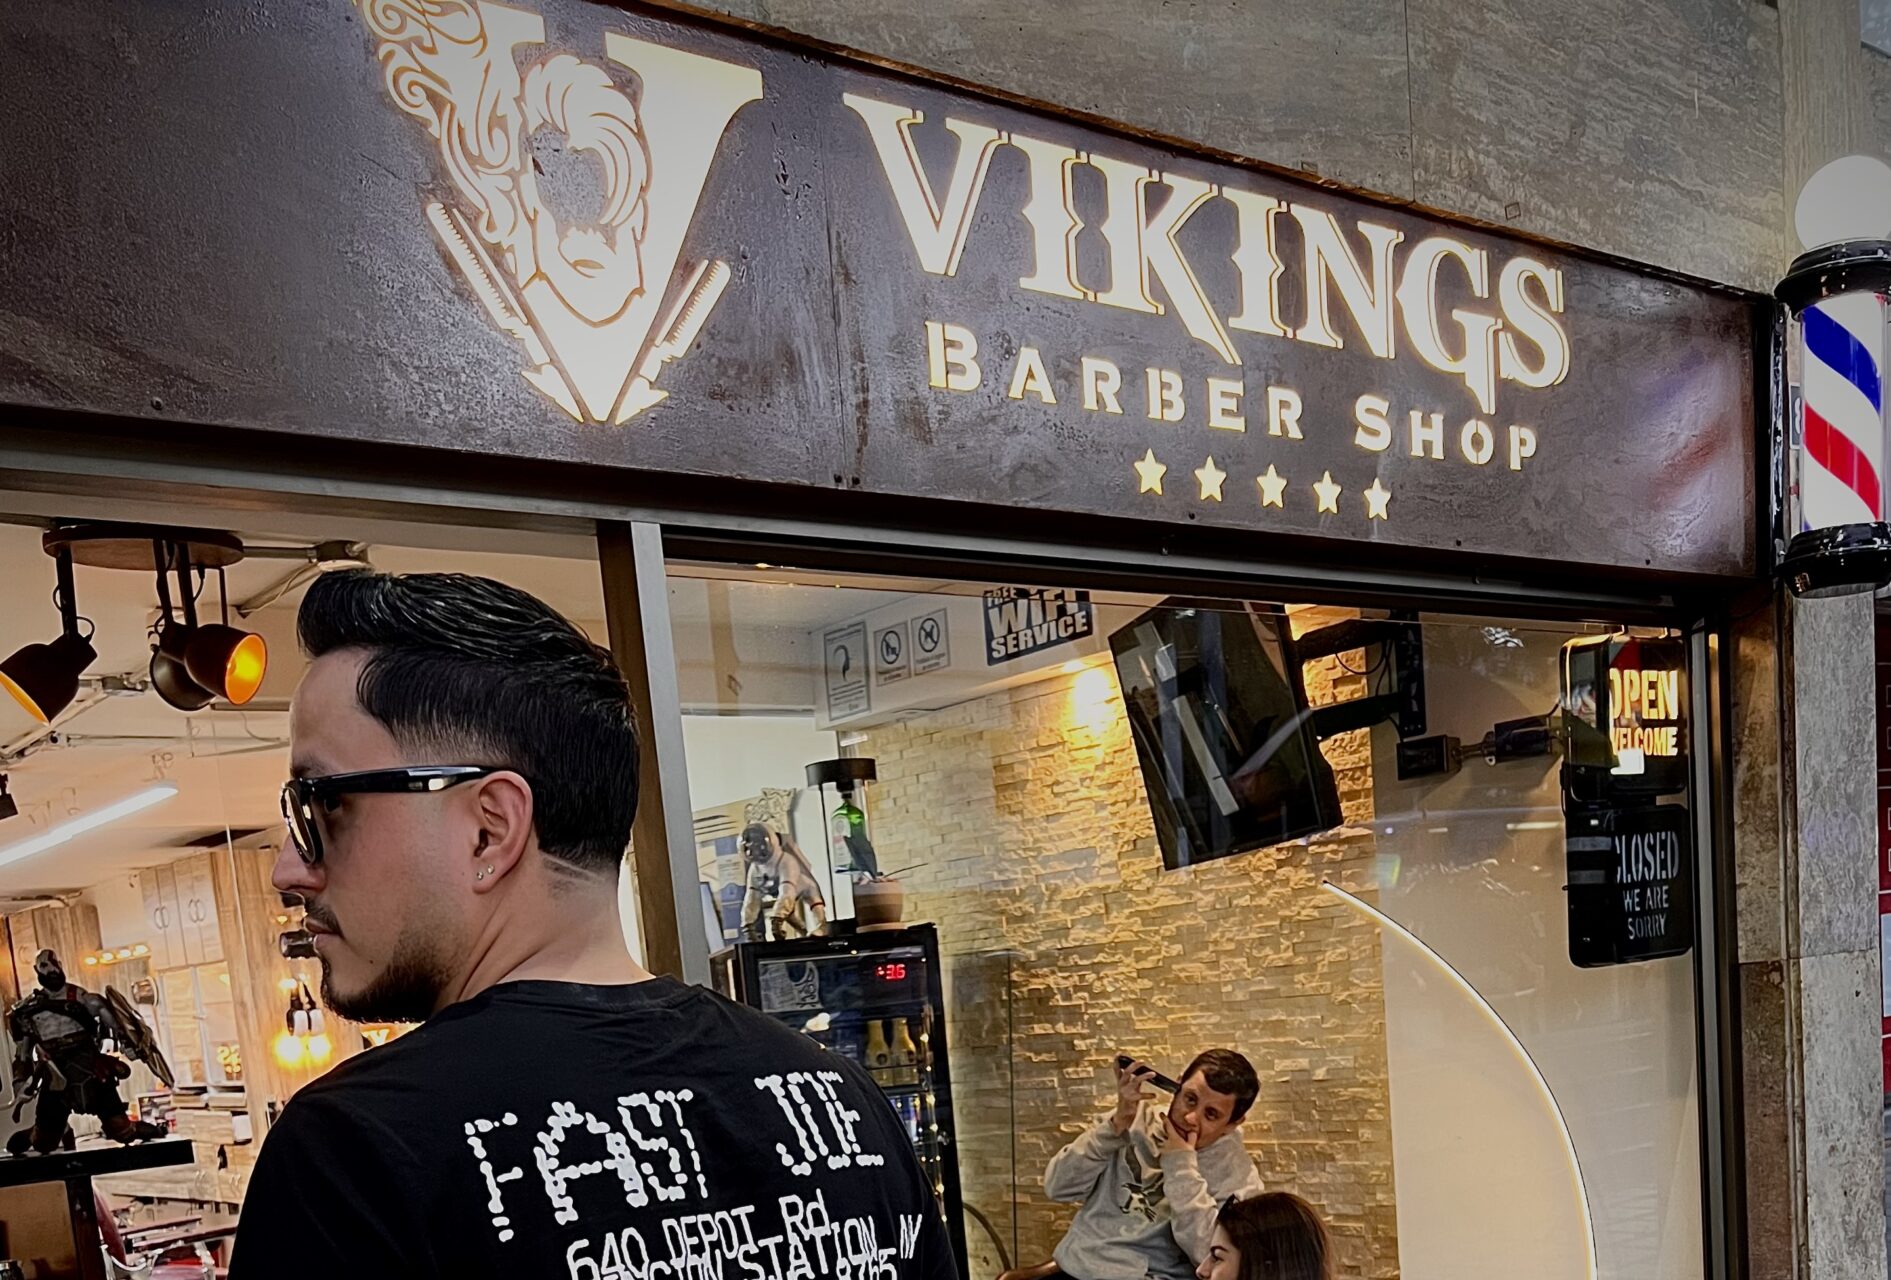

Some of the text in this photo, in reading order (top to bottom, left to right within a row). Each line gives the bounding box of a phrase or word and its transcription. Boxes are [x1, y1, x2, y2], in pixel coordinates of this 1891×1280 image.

[842, 93, 1570, 415] VIKINGS
[924, 320, 1539, 472] BARBER SHOP
[991, 610, 1088, 659] SERVICE
[1623, 885, 1669, 912] WE ARE
[1627, 913, 1667, 940] SORRY
[465, 1089, 709, 1243] FAST
[661, 1205, 756, 1263] DEPOT
[778, 1188, 831, 1241] Rd
